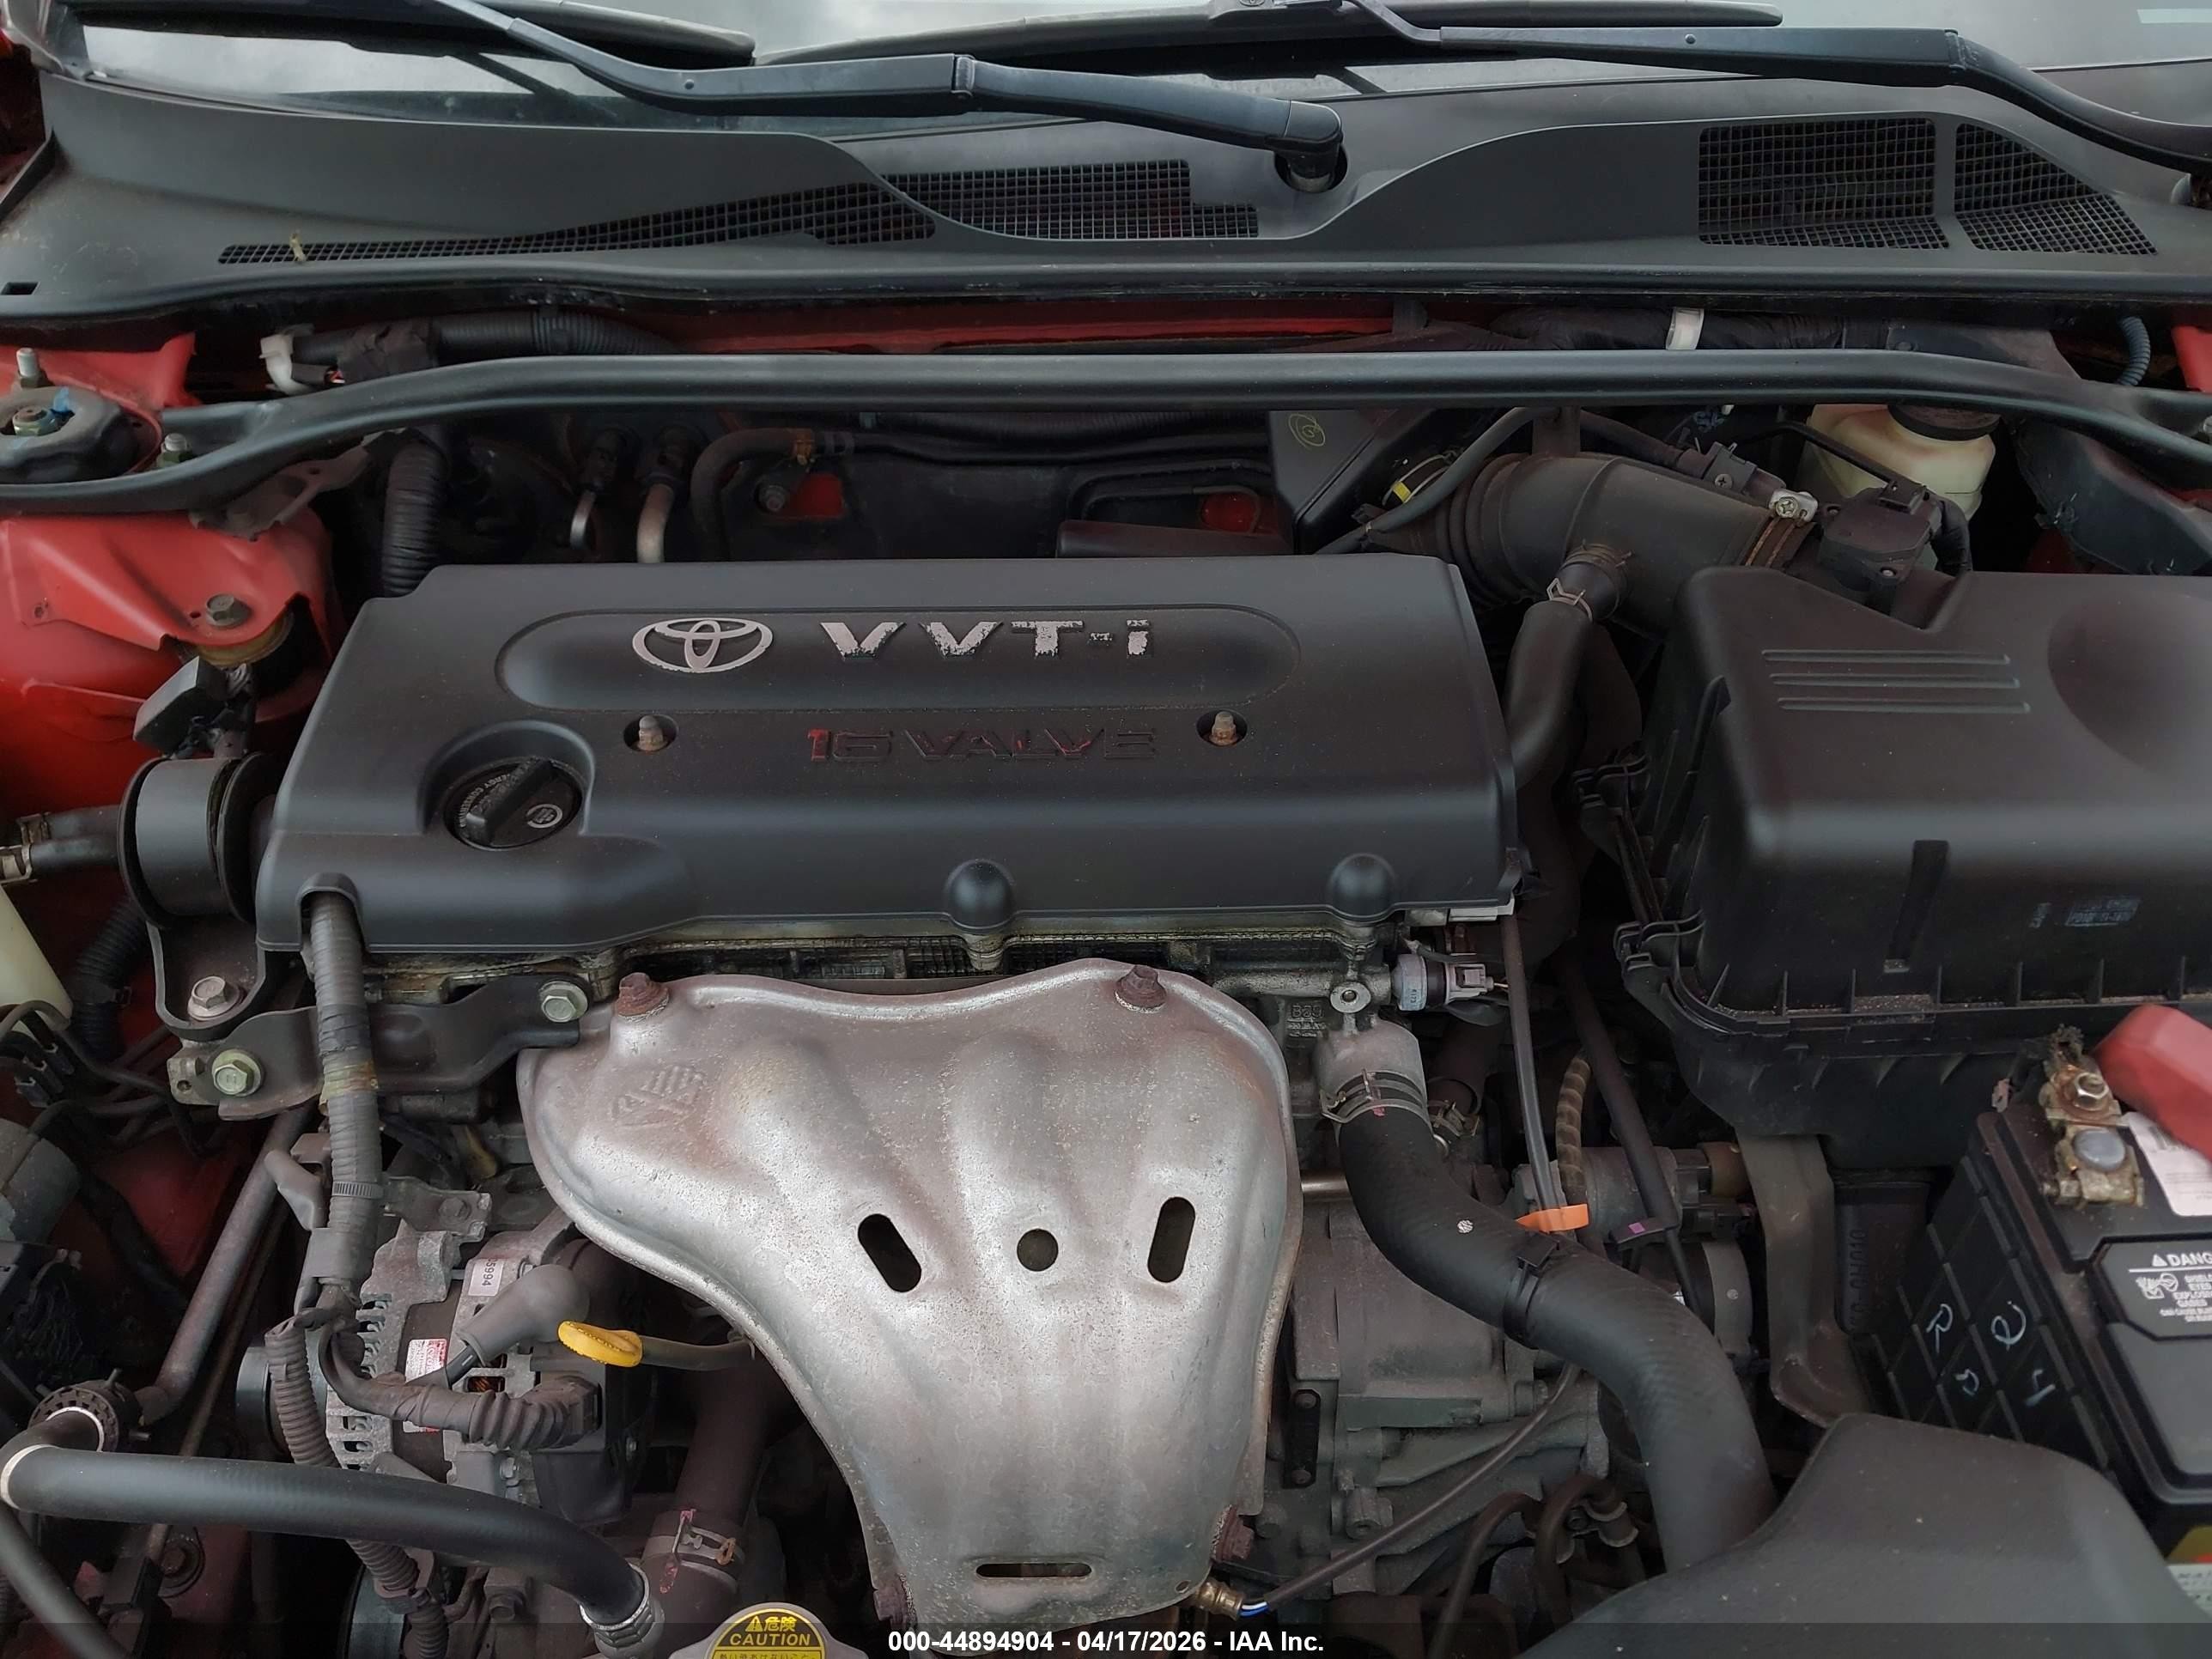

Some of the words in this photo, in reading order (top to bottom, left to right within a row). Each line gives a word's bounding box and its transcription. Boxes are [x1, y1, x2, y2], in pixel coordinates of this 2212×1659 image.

[820, 620, 1150, 659] VVT-i
[904, 728, 1156, 761] VALVE
[764, 1616, 797, 1632] 危険
[729, 1633, 811, 1645] CAUTION
